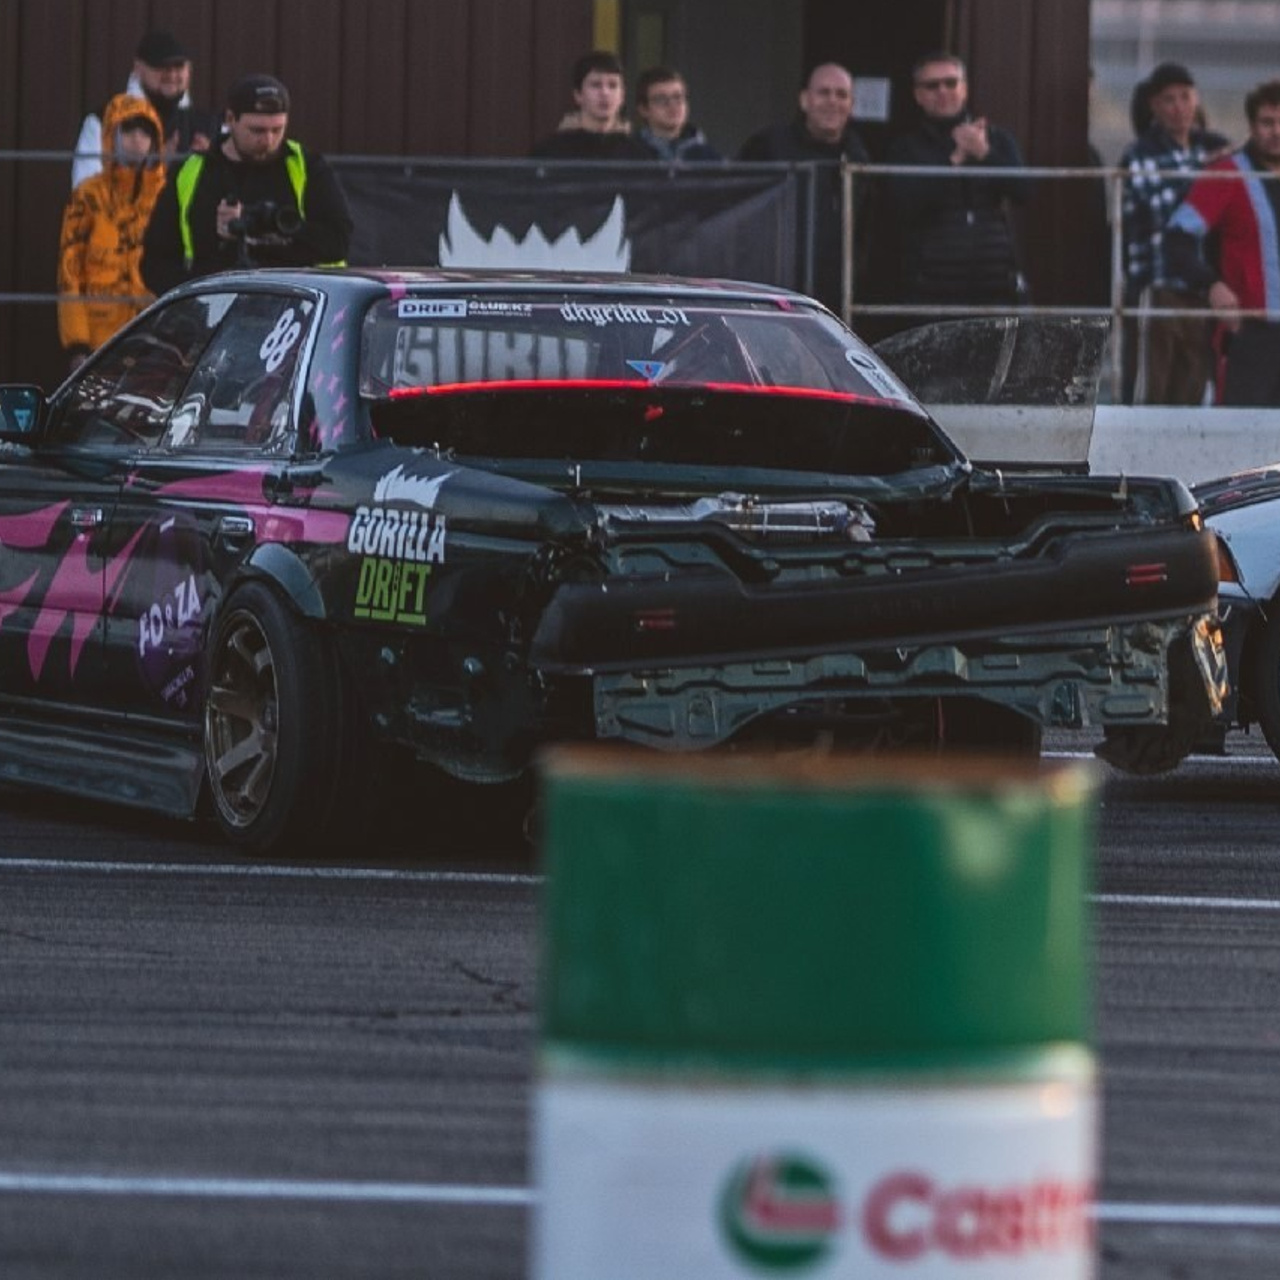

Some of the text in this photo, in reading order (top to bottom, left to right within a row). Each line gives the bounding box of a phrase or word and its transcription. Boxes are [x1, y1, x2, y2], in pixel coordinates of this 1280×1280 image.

[402, 303, 461, 313] DRIFT
[259, 308, 301, 372] 88
[348, 506, 446, 564] GORILLA
[355, 557, 432, 622] DRIFT
